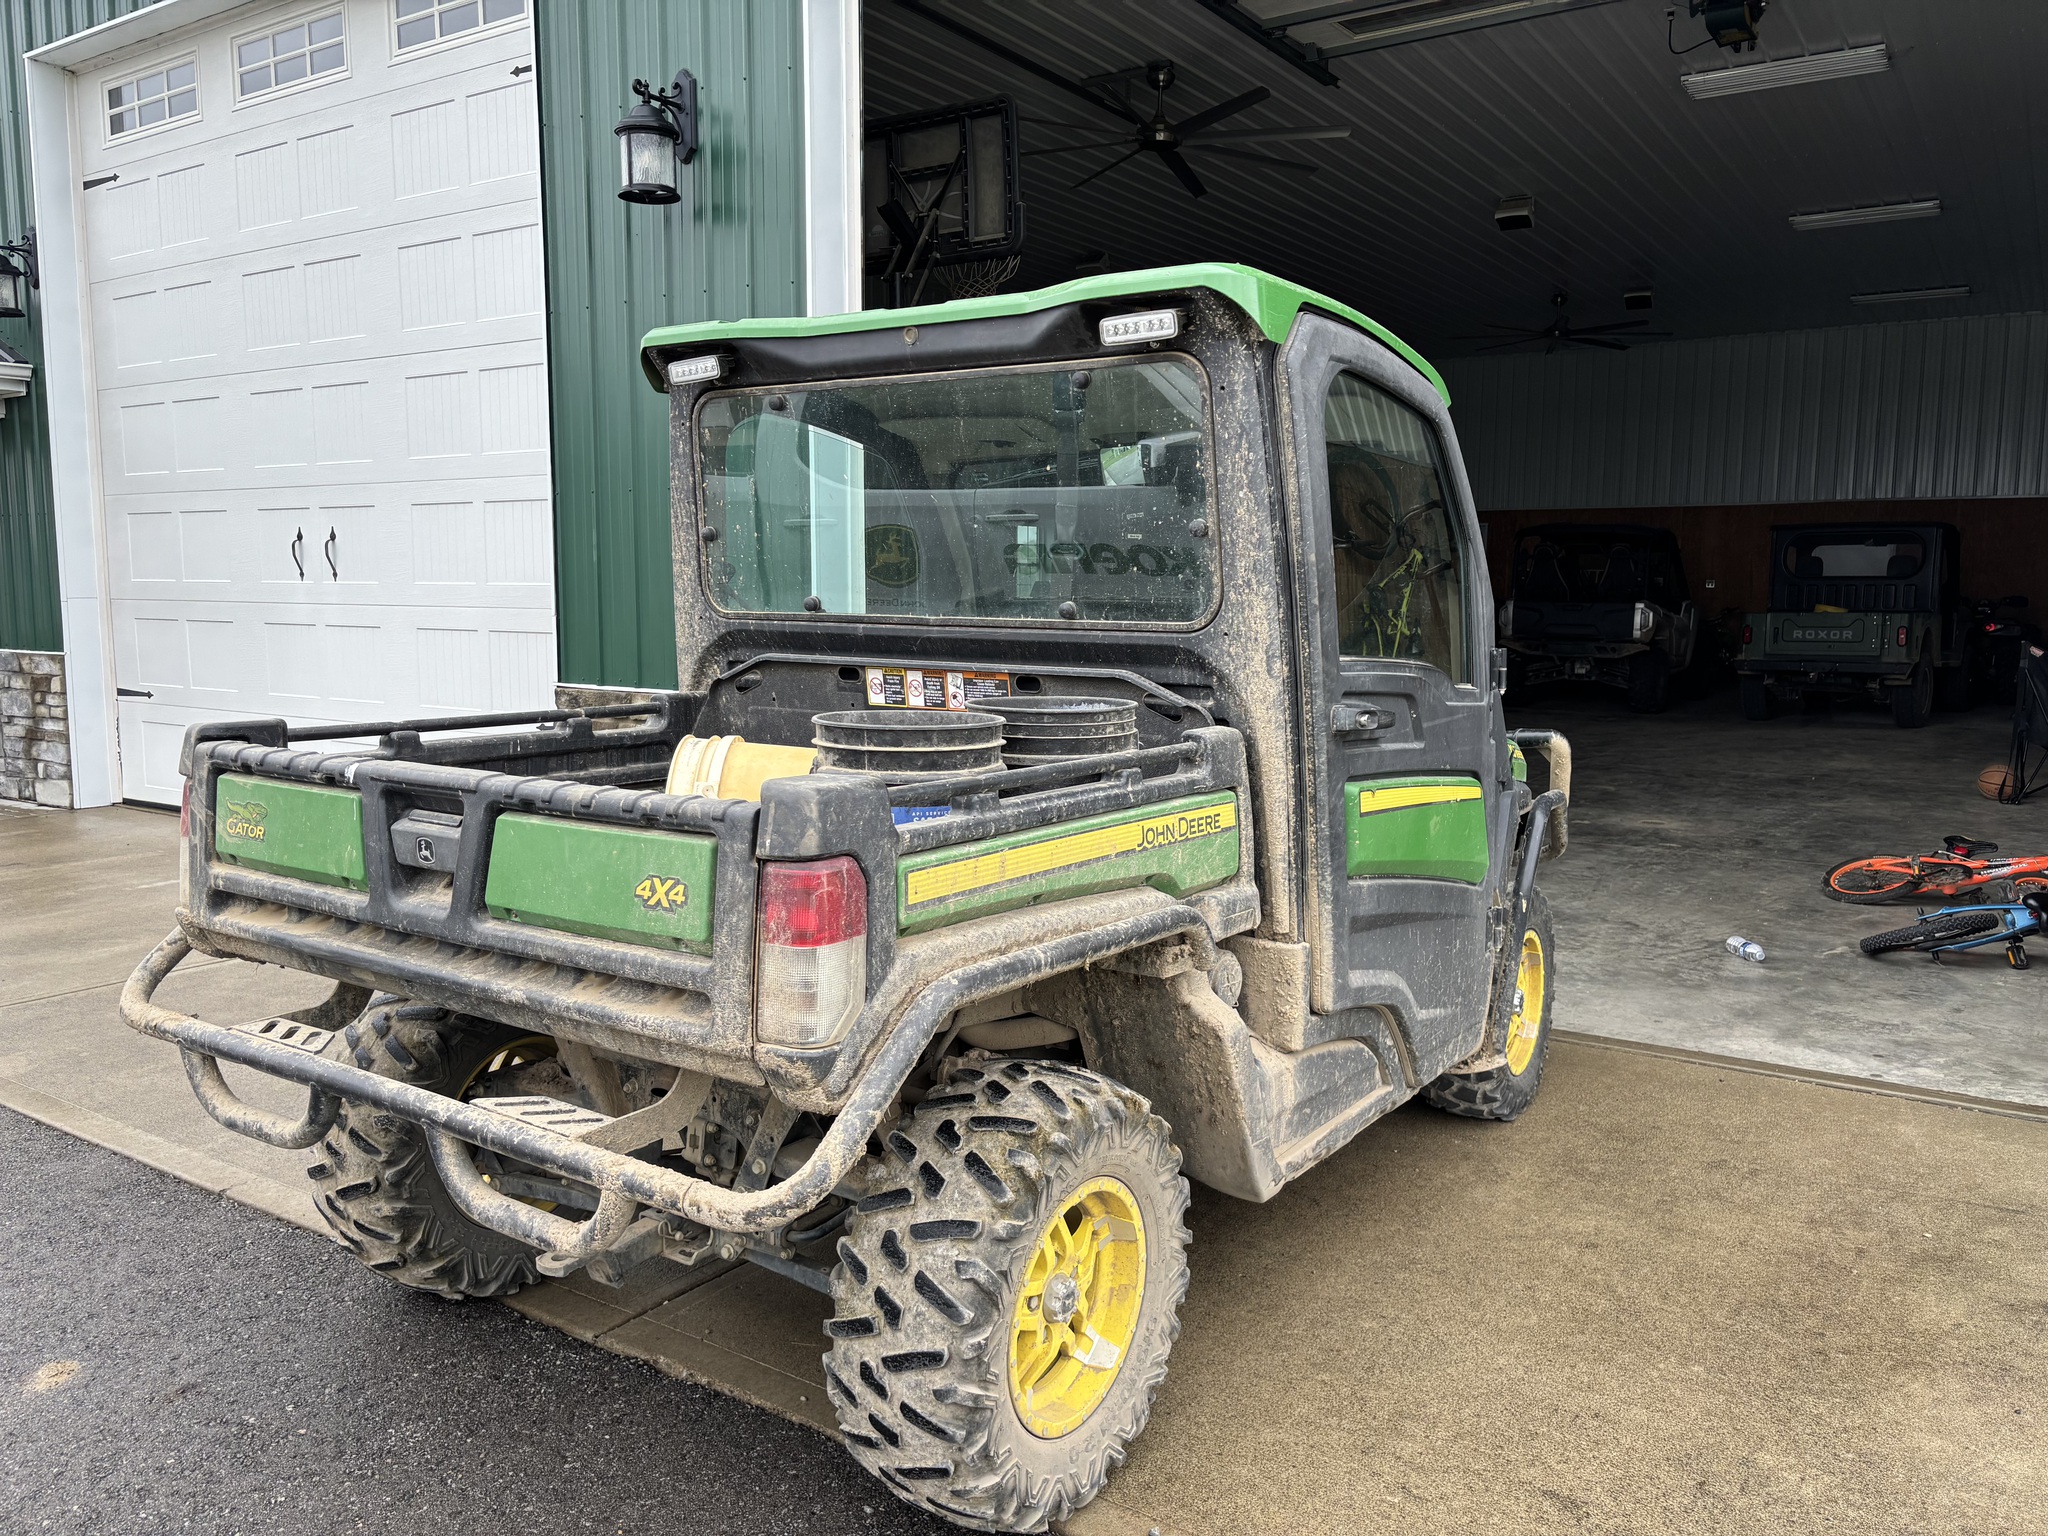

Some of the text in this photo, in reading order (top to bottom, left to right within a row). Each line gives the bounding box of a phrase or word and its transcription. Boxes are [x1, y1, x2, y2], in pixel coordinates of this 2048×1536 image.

[1793, 630, 1853, 639] ROXOR
[226, 818, 265, 839] GATOR
[1137, 812, 1221, 847] JOHN DEERE
[635, 877, 686, 908] 4X4
